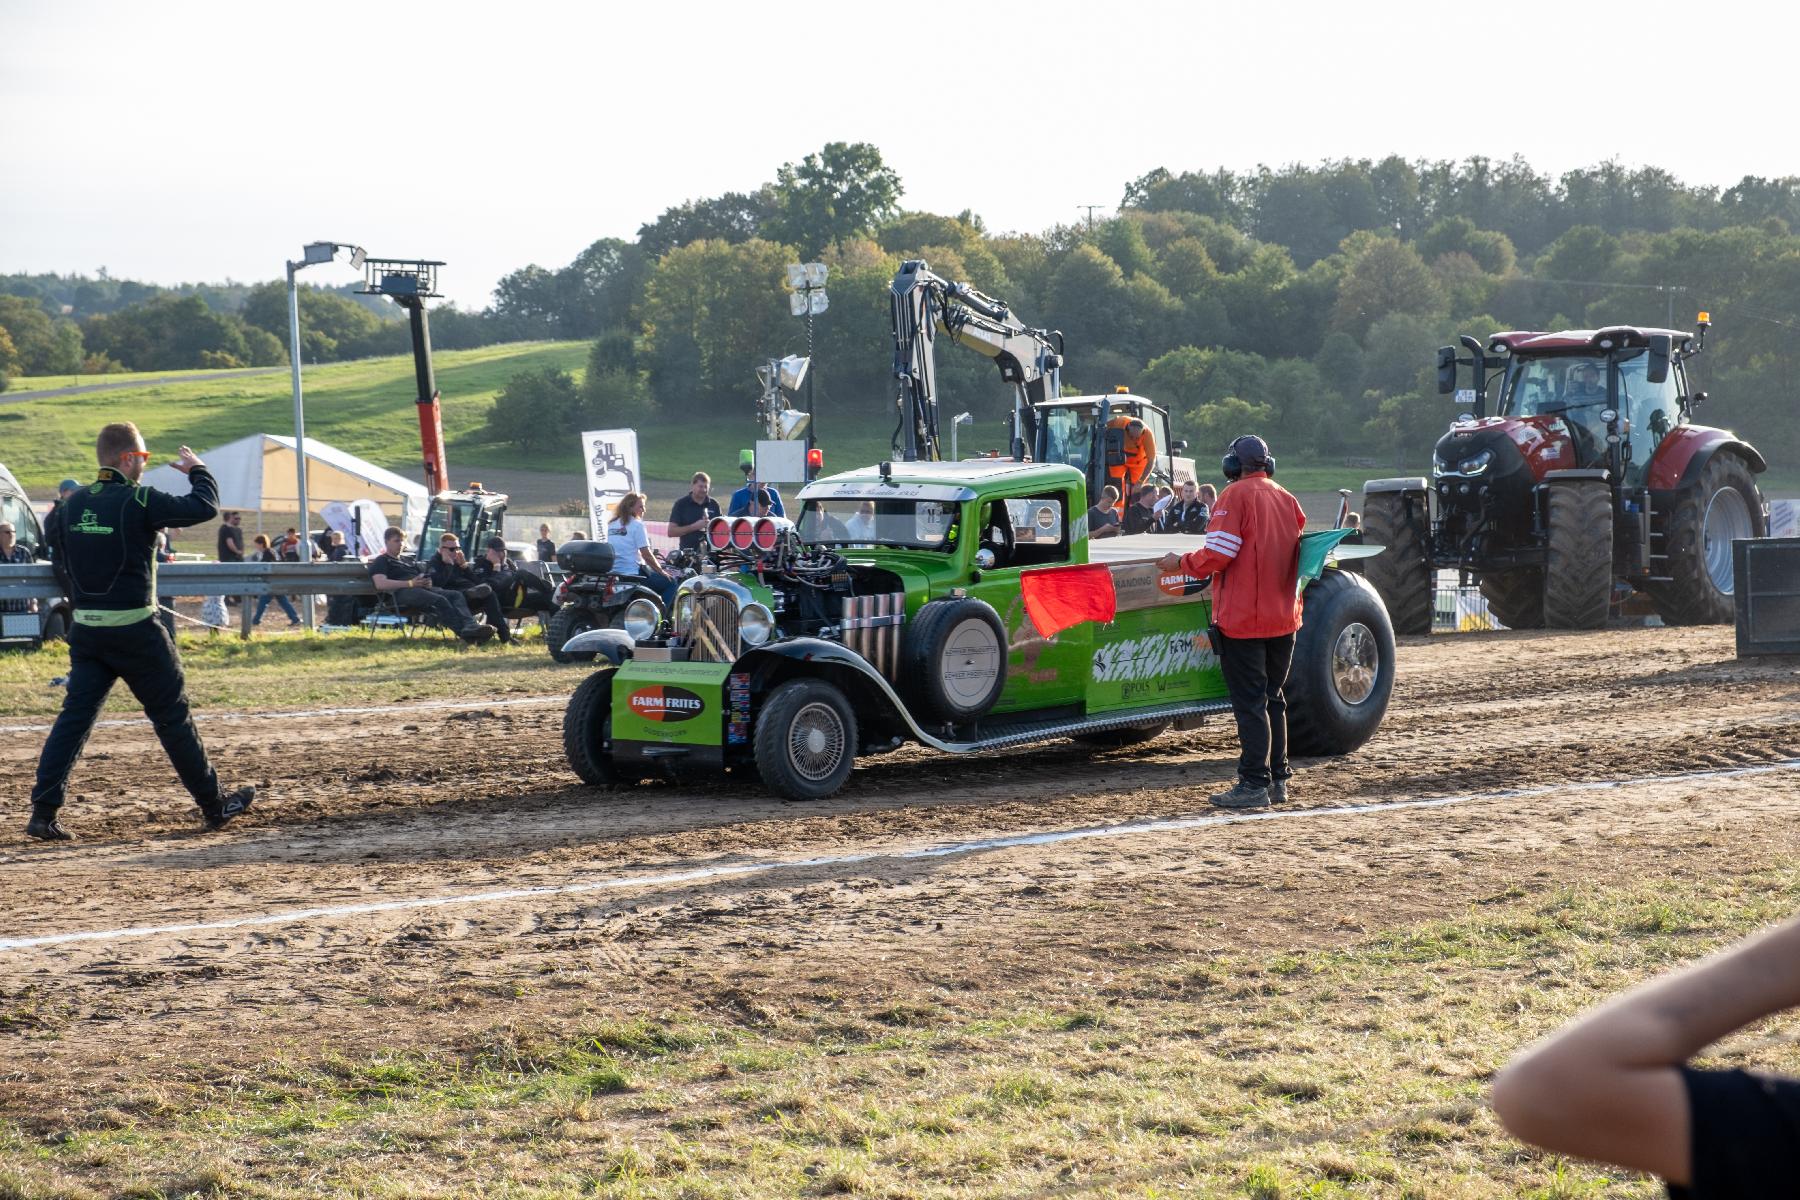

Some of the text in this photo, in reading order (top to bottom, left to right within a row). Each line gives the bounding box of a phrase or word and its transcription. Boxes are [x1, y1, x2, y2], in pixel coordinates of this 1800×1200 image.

[1115, 576, 1152, 589] RANDING
[1161, 574, 1183, 586] FARM
[632, 696, 701, 709] FARM FRITES
